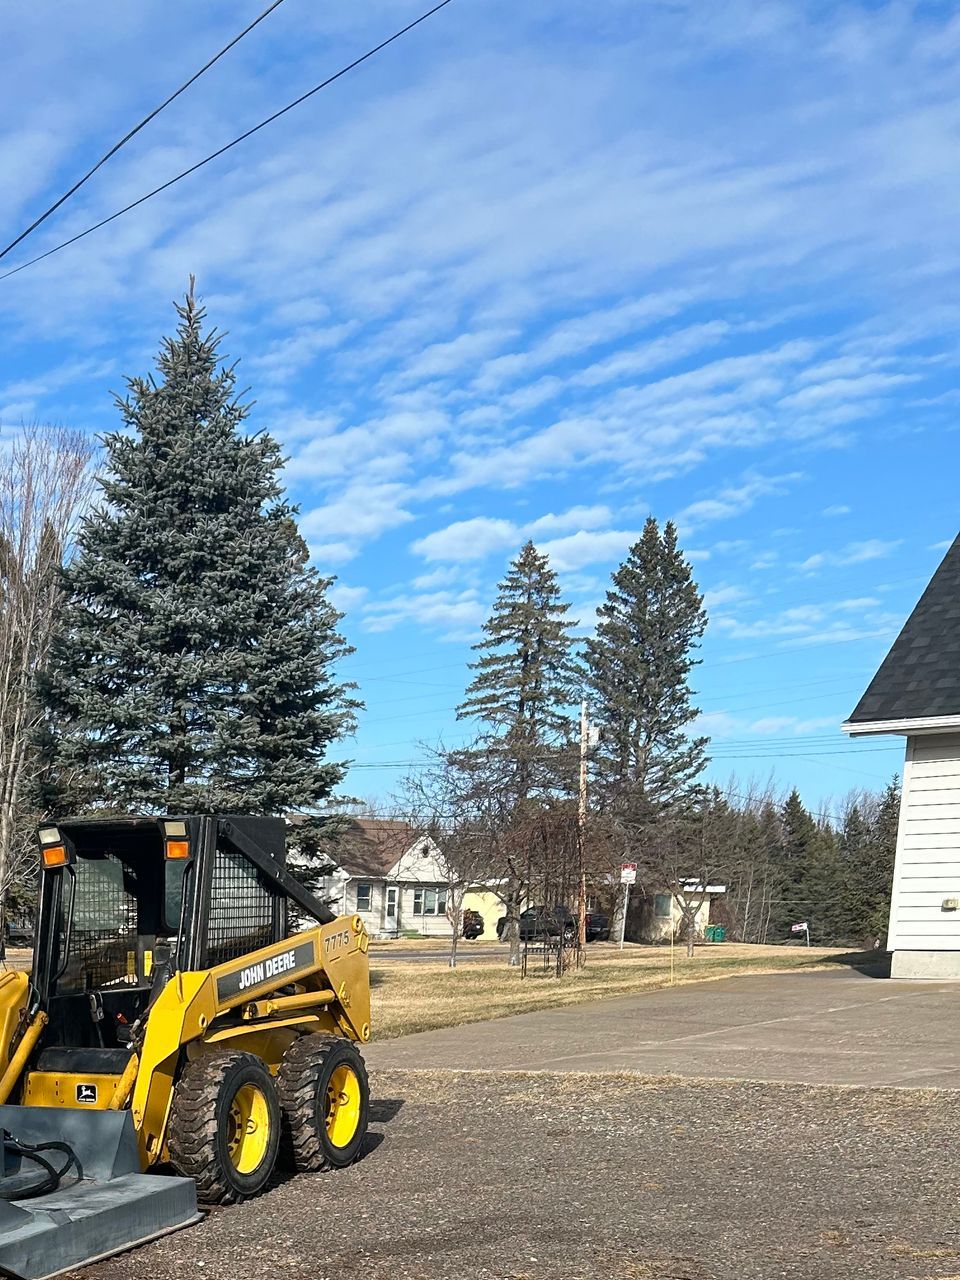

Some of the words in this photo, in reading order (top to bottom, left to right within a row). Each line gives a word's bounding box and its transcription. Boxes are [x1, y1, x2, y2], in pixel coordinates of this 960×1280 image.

[324, 930, 349, 952] 7775
[239, 964, 265, 990] JOHN
[266, 950, 296, 978] DEERE
